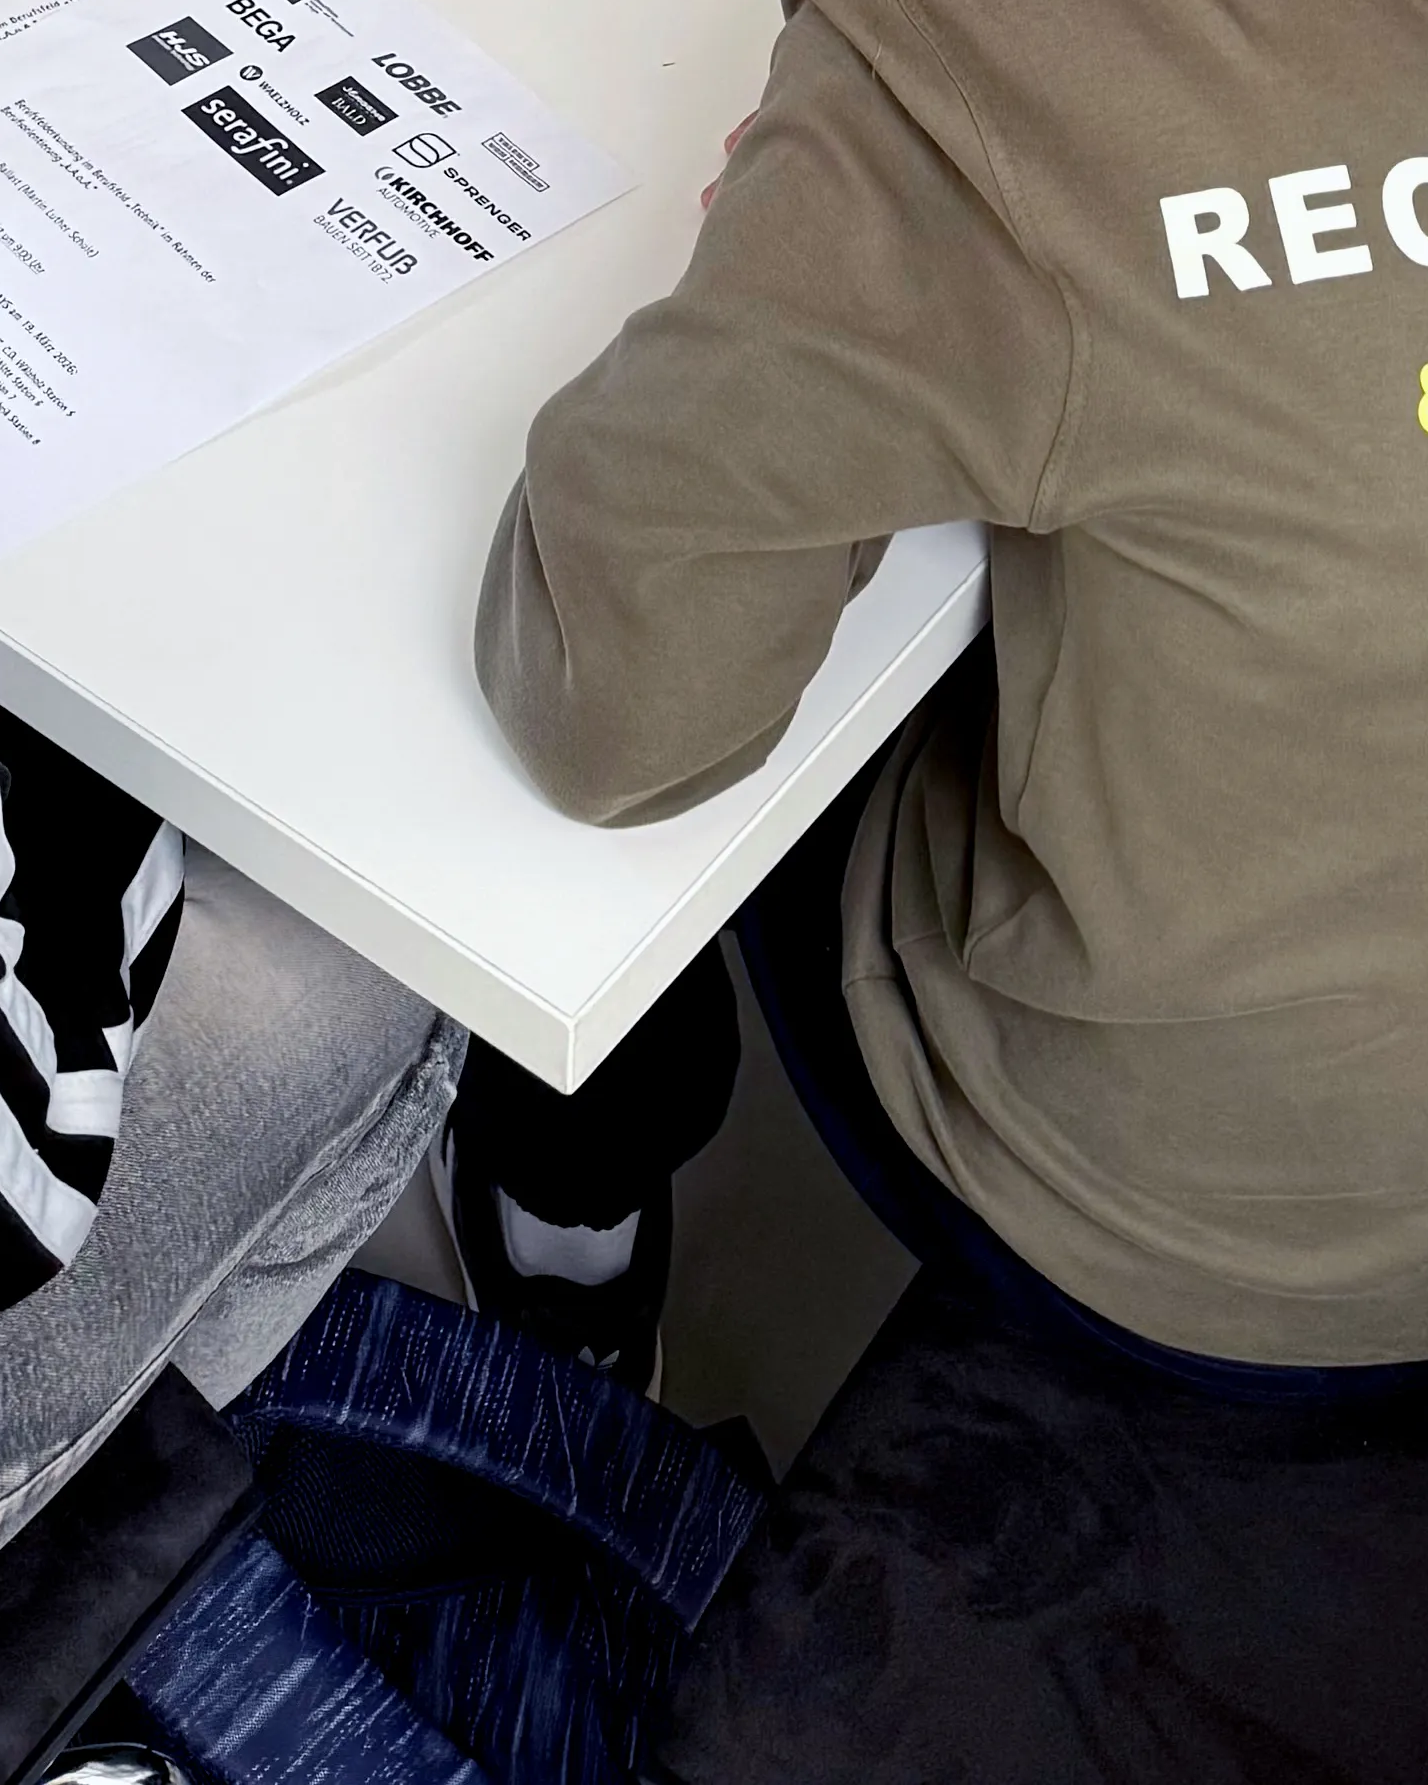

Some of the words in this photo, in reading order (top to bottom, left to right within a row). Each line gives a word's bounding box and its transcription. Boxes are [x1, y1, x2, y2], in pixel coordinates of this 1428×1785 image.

[158, 31, 210, 67] HJS
[259, 81, 310, 127] WAELZHOLZ
[371, 53, 462, 118] LOBBE
[0, 105, 63, 163] Berufsorientierung
[332, 97, 367, 127] BALD
[13, 98, 85, 163] Berufsfelderkundung
[81, 160, 94, 171] im
[91, 169, 132, 203] Berufsfeld
[160, 231, 174, 244] im
[171, 241, 203, 272] Rahmen
[200, 270, 217, 283] der
[377, 187, 441, 240] AUTOMOTIVE
[443, 167, 532, 241] SPRENGER
[44, 208, 71, 233] Luther
[313, 215, 348, 246] BAUEN
[346, 241, 371, 262] SEIT
[389, 177, 495, 263] KIRCHHOFF
[8, 308, 23, 321] am
[32, 331, 56, 353] März
[11, 376, 37, 402] Station
[42, 386, 68, 412] Station
